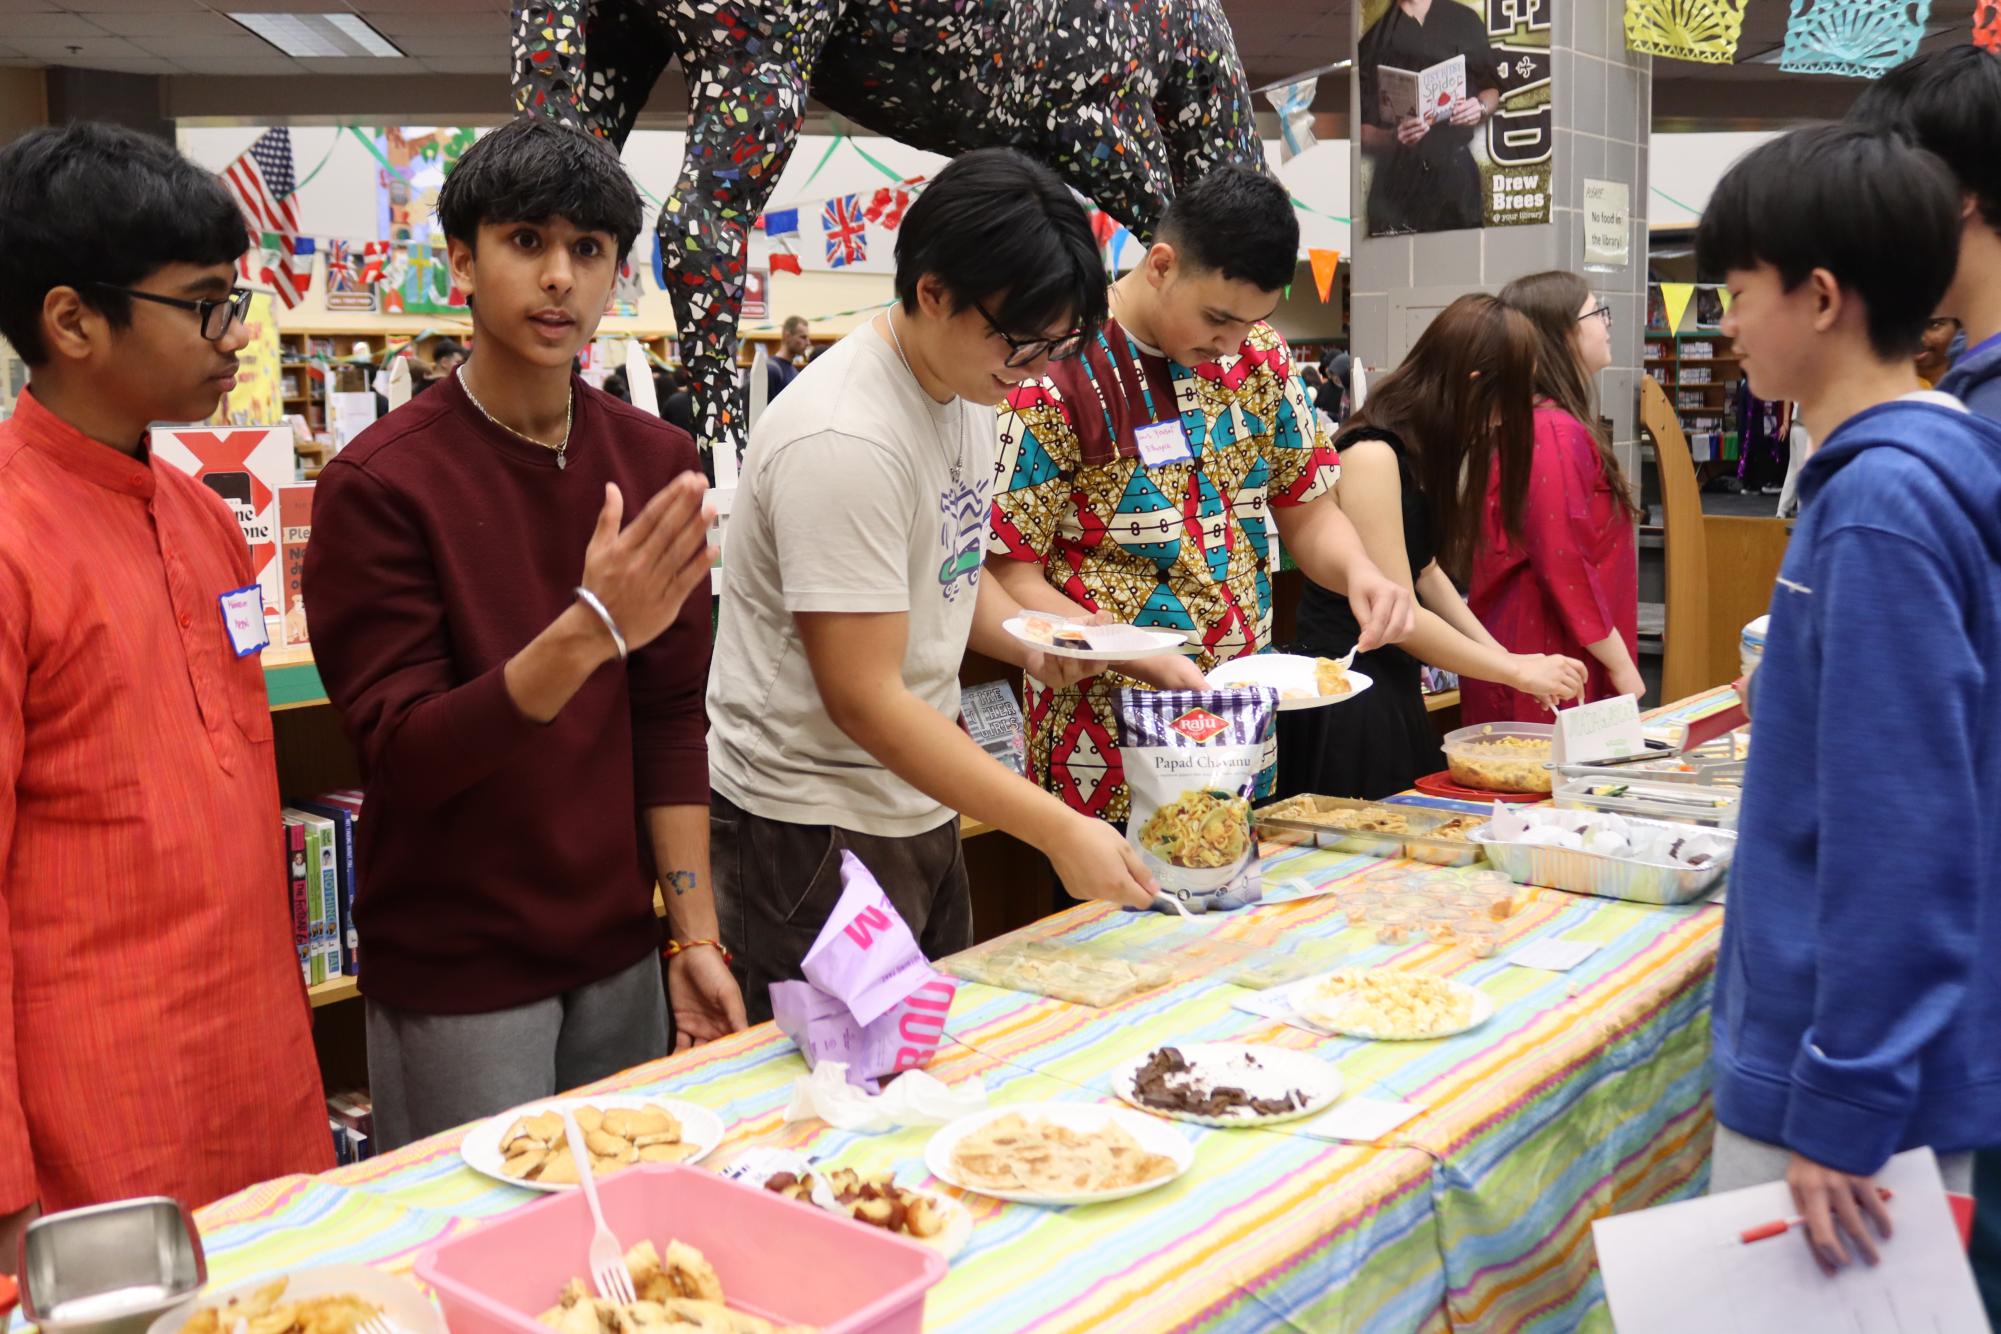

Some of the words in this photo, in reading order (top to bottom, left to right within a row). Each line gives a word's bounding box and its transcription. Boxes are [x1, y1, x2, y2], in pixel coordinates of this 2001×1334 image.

[1493, 174, 1538, 192] Drew
[1493, 193, 1544, 210] Brees
[1502, 212, 1518, 223] your
[1520, 211, 1544, 220] library
[1592, 212, 1600, 223] No
[1602, 212, 1614, 224] food
[1592, 233, 1601, 246] the
[980, 717, 1019, 738] GIRLS
[1154, 756, 1193, 772] Papad
